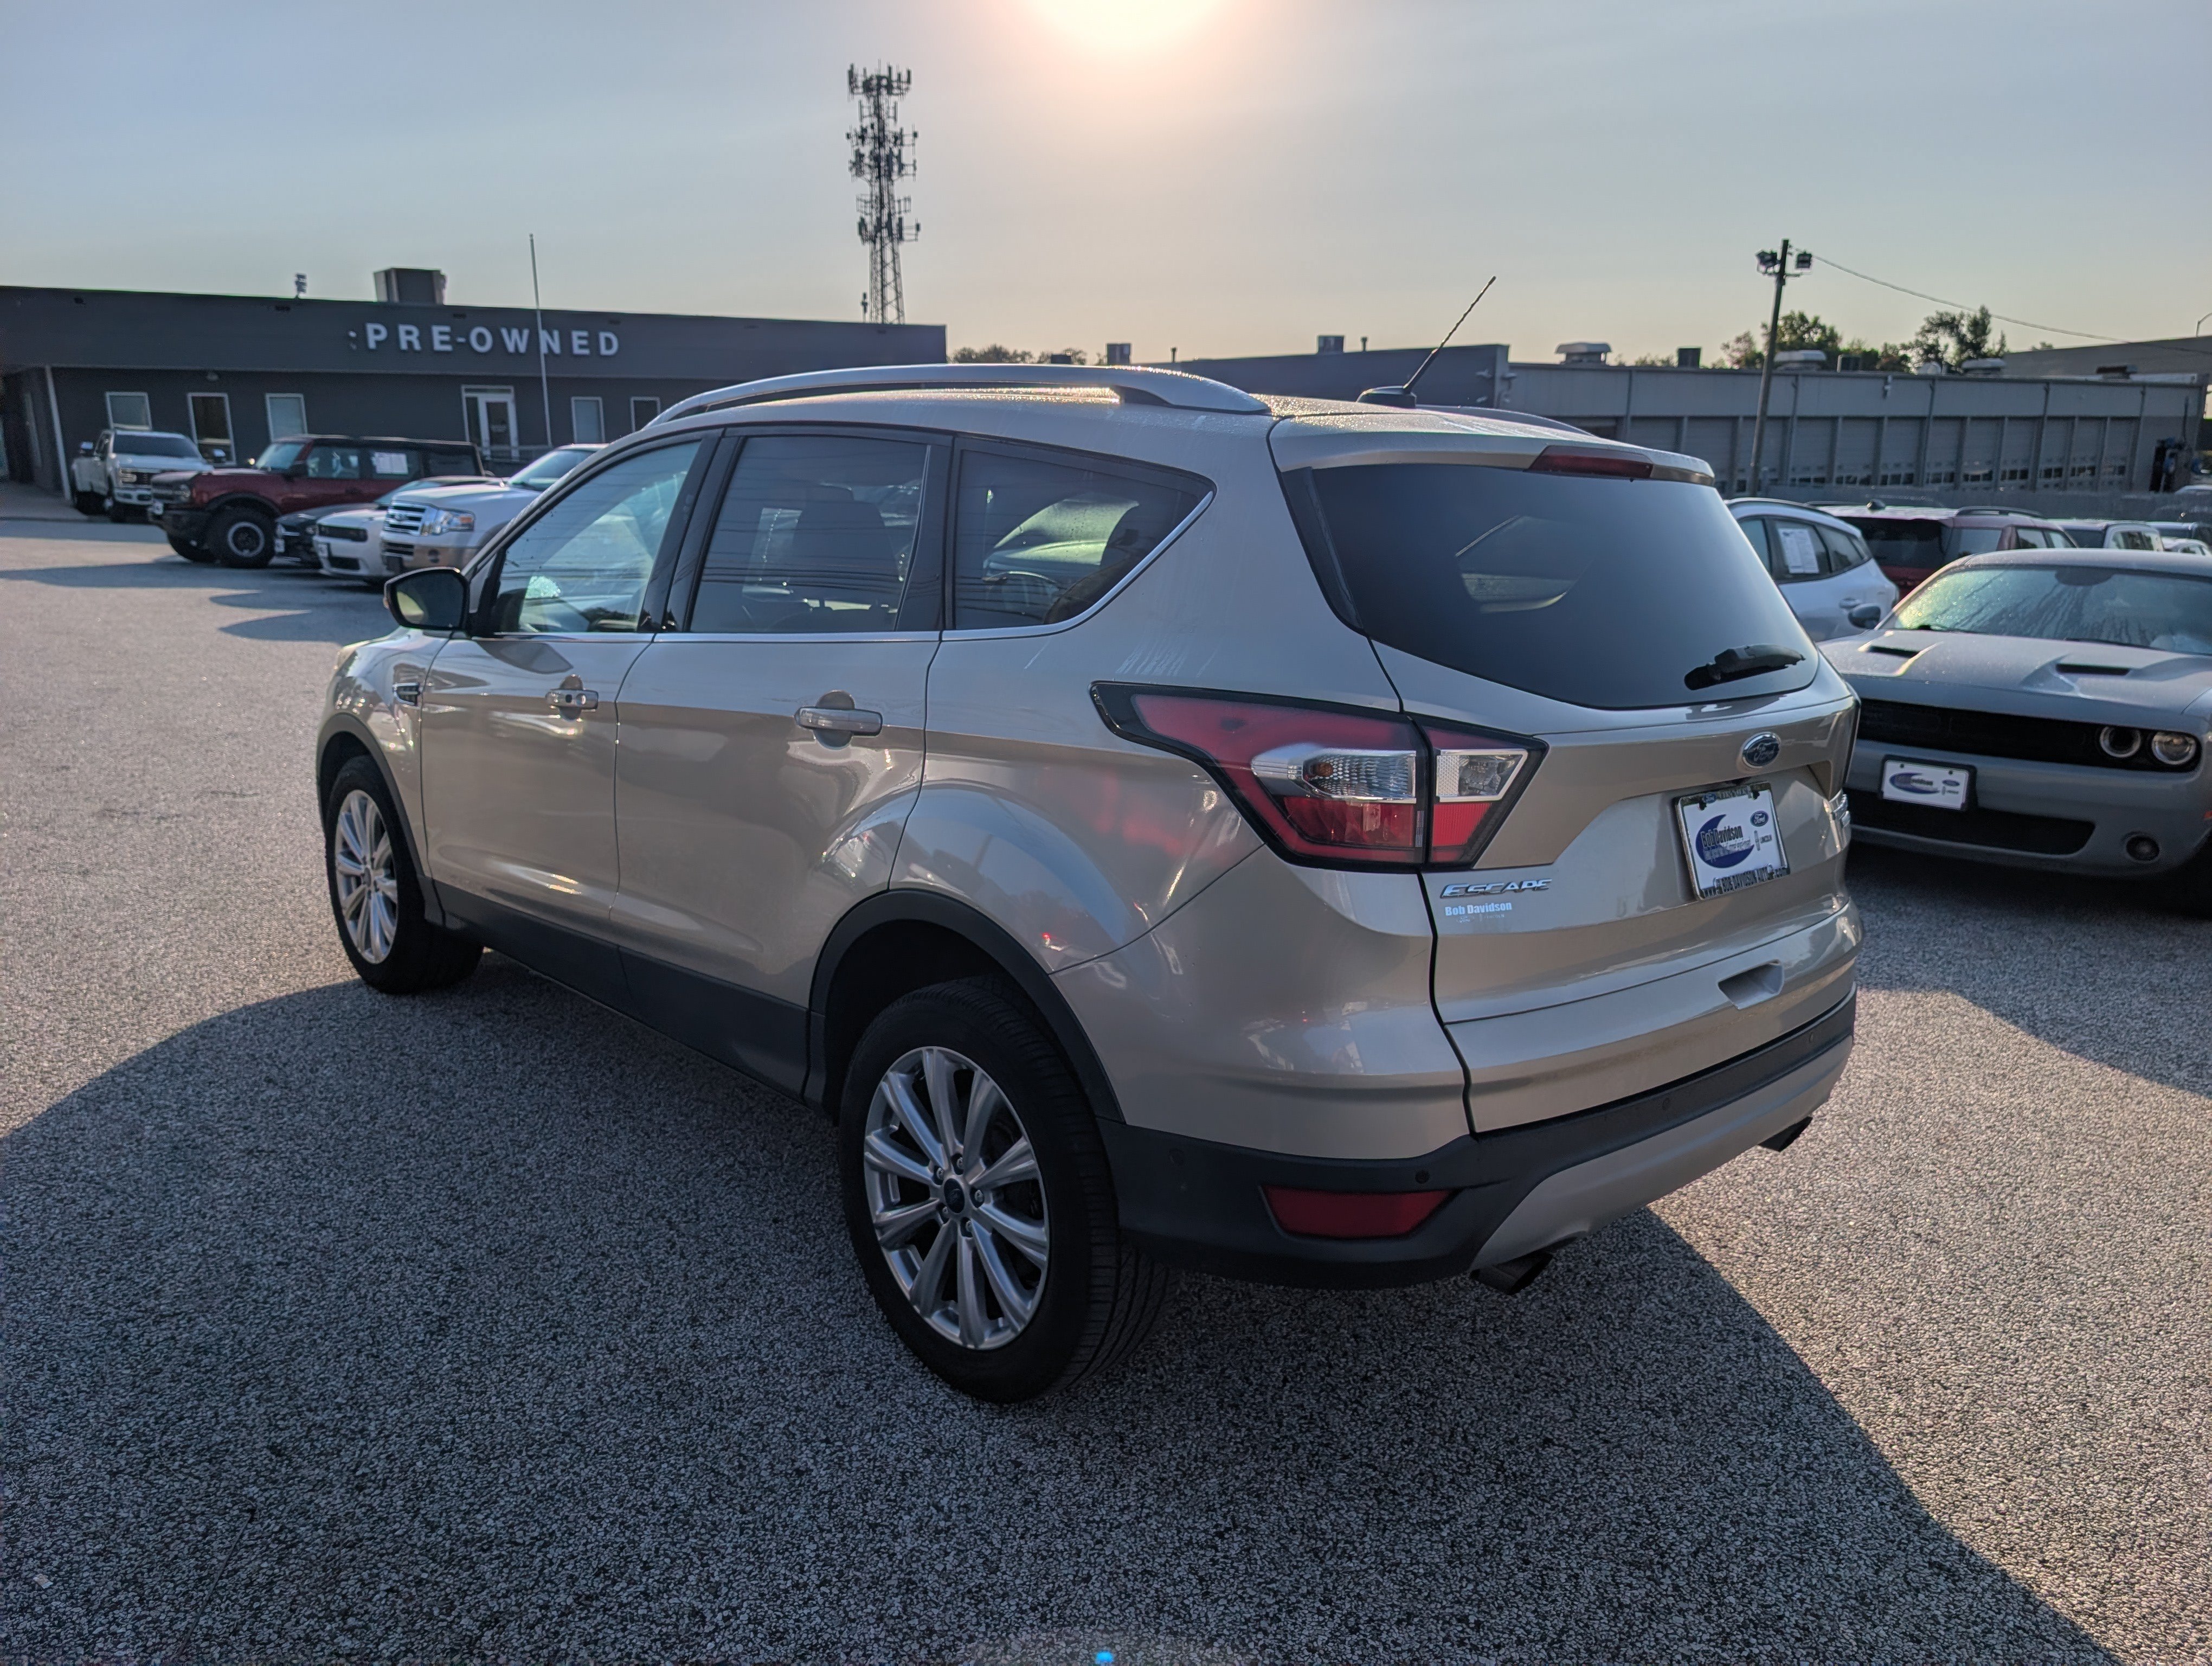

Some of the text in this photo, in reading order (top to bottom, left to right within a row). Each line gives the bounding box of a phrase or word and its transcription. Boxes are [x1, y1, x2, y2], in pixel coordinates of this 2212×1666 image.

[365, 322, 619, 357] PRE-OWNED
[1714, 825, 1744, 844] Davidson
[1440, 878, 1553, 899] ESCAPE
[1444, 902, 1513, 916] Bob Davidson
